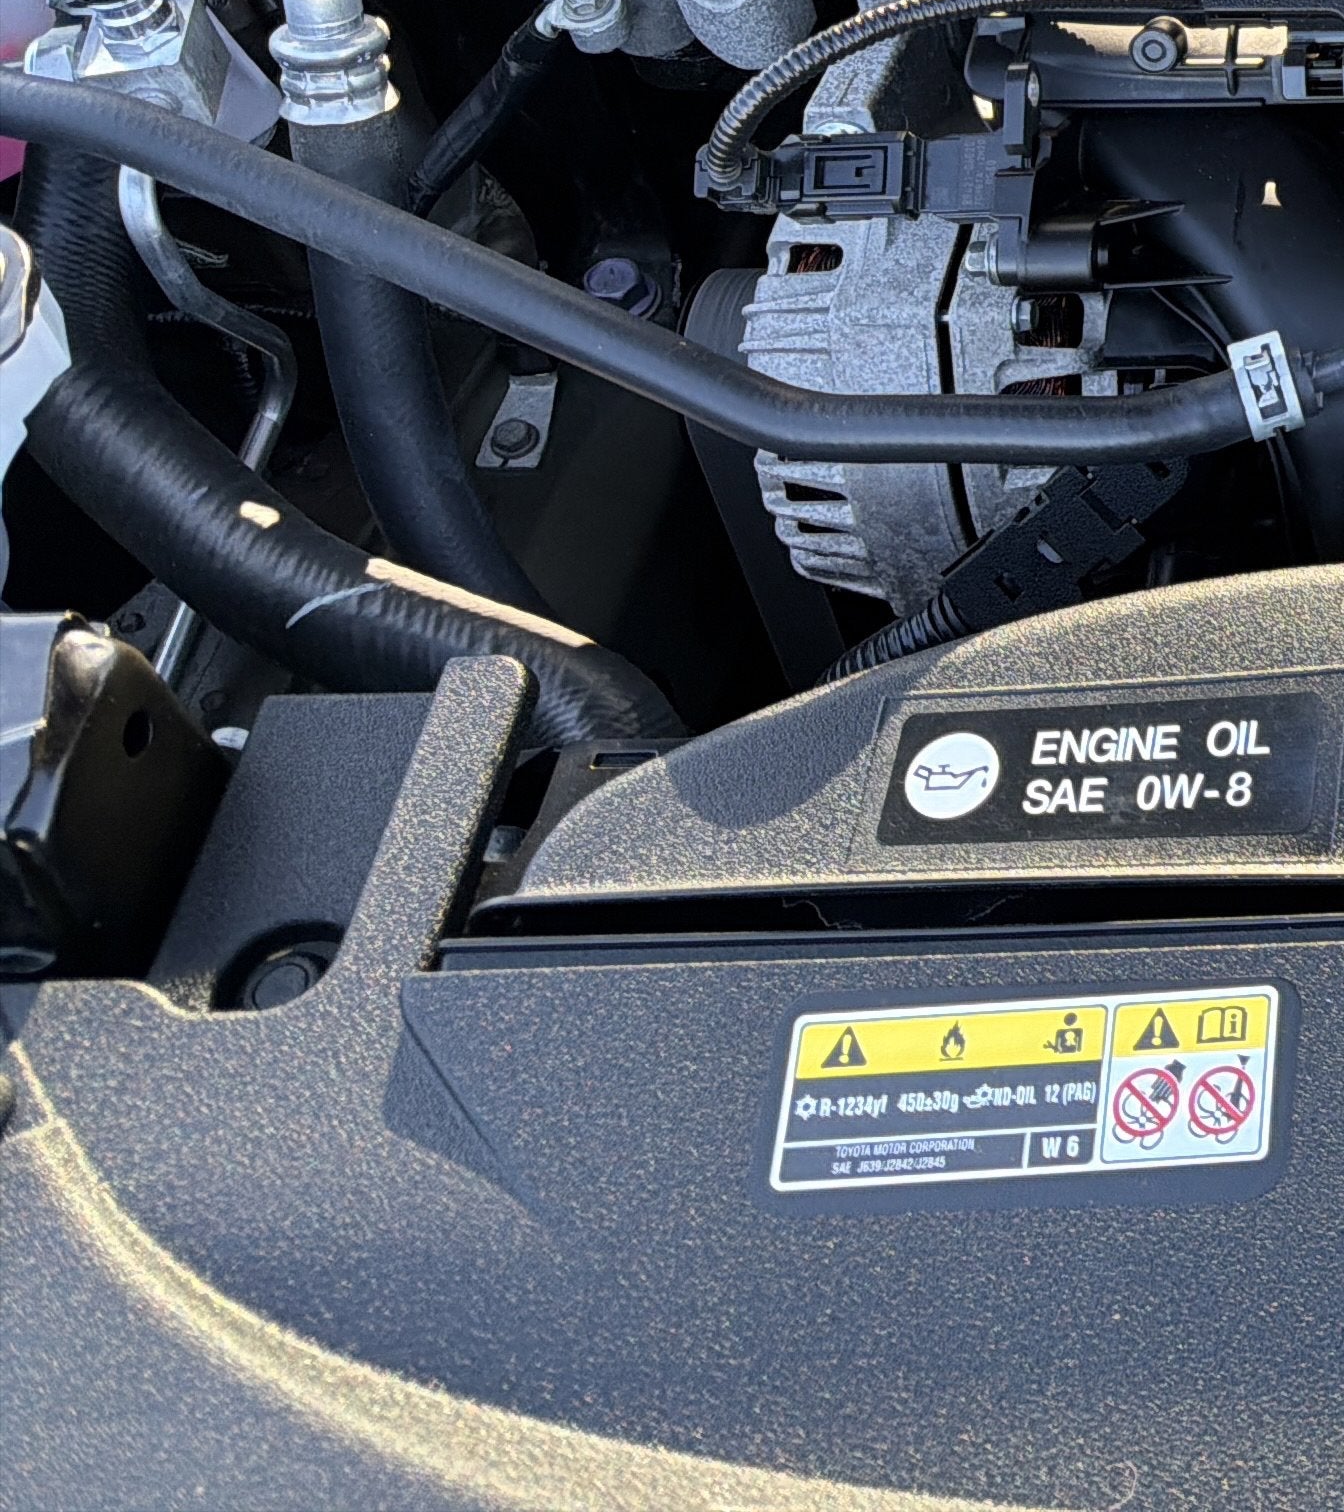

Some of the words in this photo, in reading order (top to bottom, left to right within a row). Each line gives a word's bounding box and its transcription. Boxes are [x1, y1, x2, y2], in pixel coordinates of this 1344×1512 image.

[1031, 724, 1181, 765] ENGINE
[1206, 720, 1271, 759] OIL
[1022, 778, 1108, 815] SAE
[1136, 771, 1252, 811] 0W-8
[819, 1094, 887, 1118] R-1234yf
[897, 1090, 959, 1113] 450±30g
[993, 1085, 1037, 1106] ND-OIL
[1045, 1084, 1060, 1104] 12
[1062, 1080, 1097, 1106] (PAG)
[836, 1144, 871, 1158] TOYOTA
[873, 1142, 907, 1156] MOTOR
[908, 1139, 975, 1154] CORPORATION
[1042, 1138, 1061, 1159] W
[1067, 1135, 1080, 1157] 6
[831, 1161, 851, 1175] SAE
